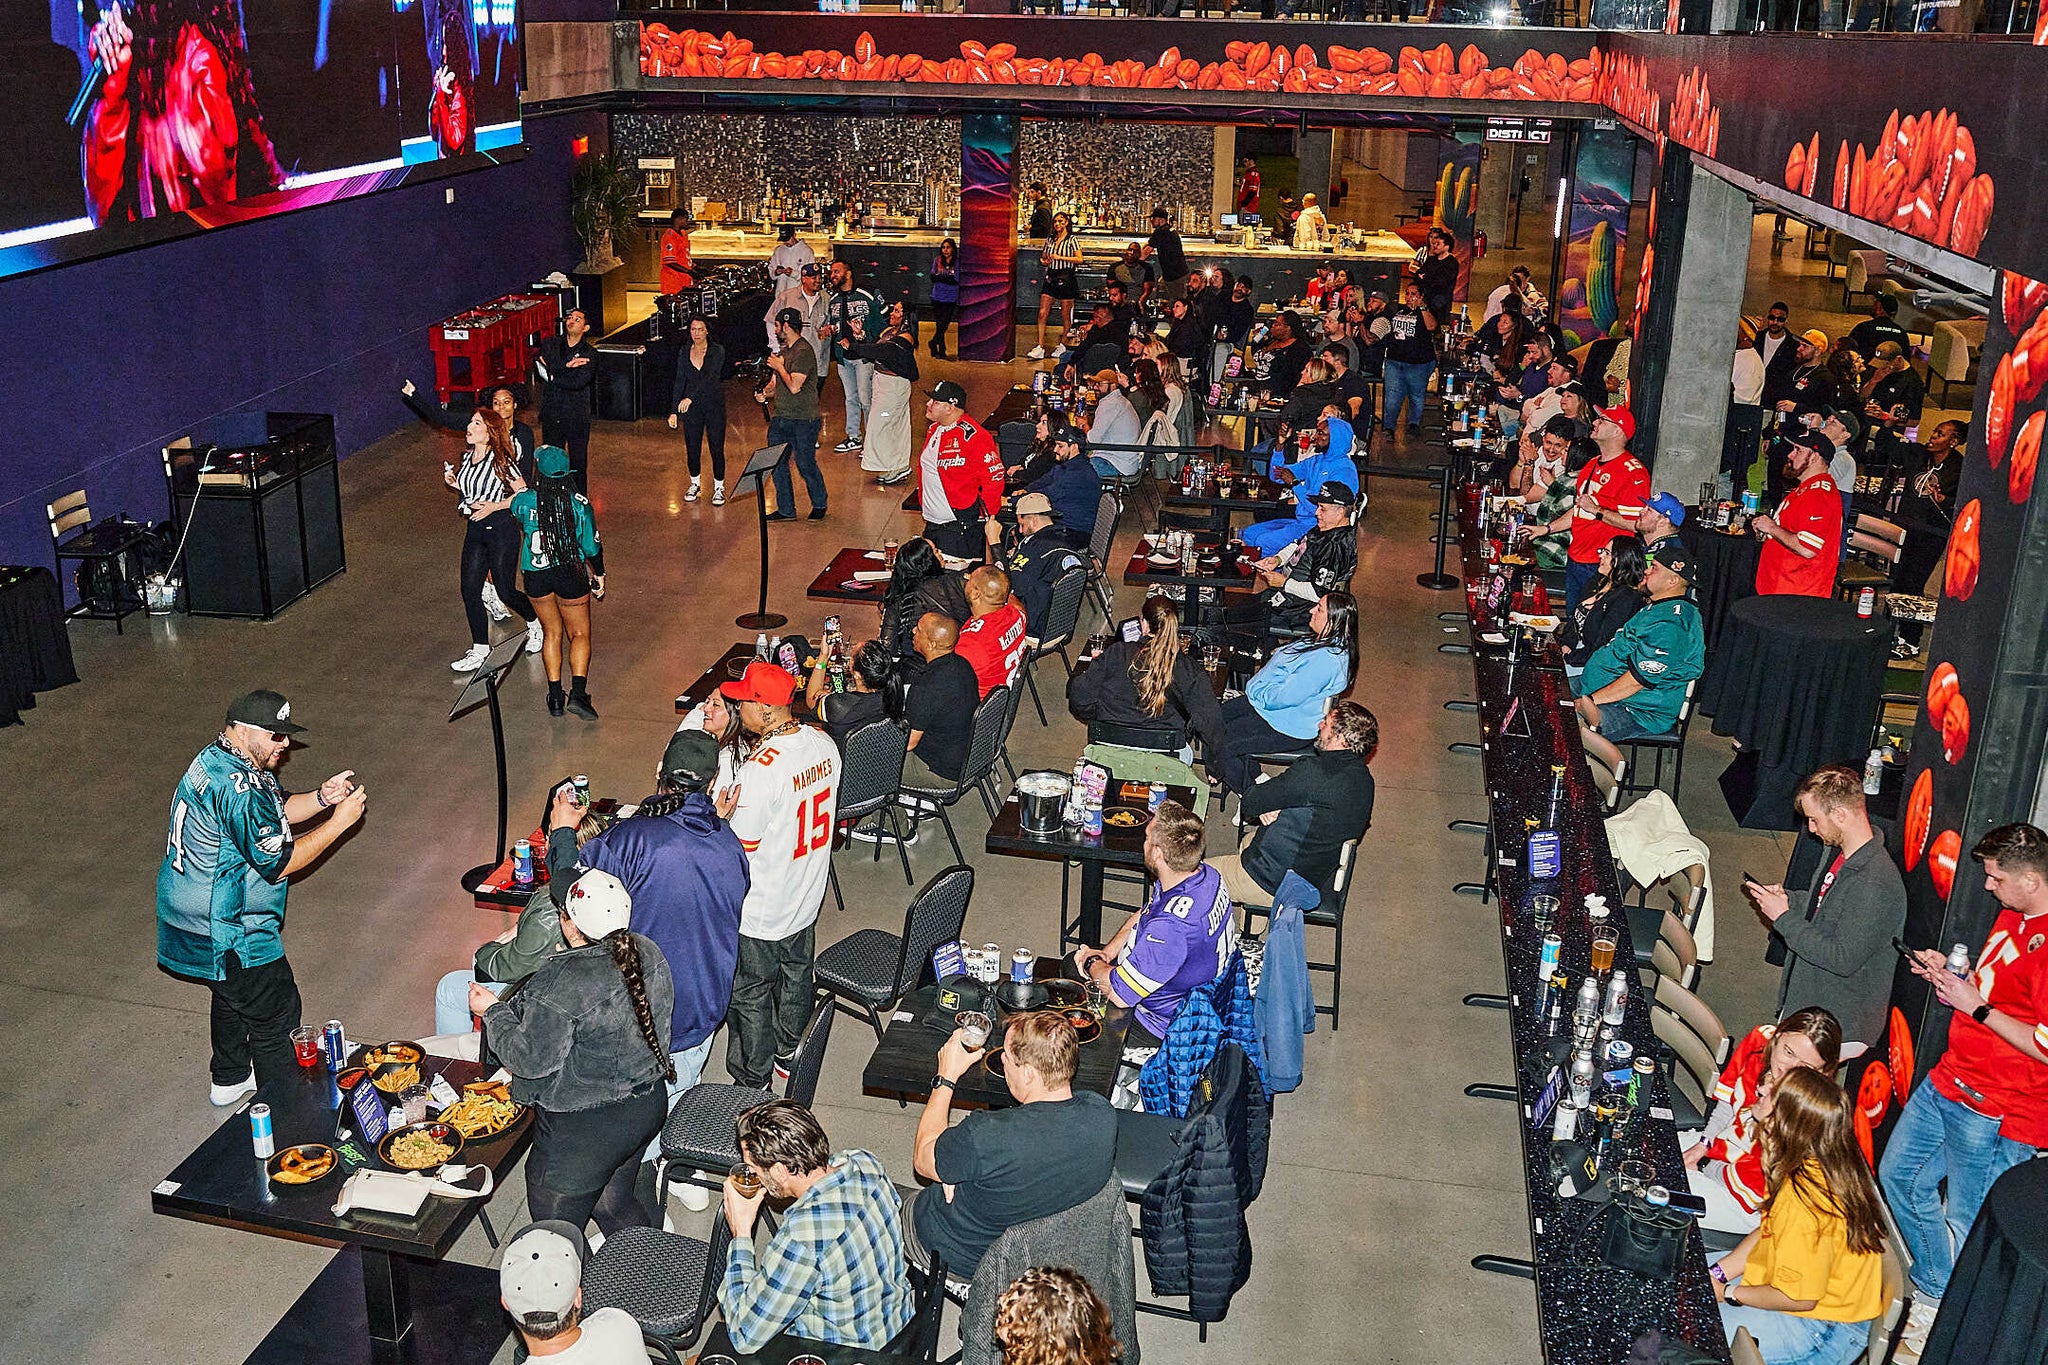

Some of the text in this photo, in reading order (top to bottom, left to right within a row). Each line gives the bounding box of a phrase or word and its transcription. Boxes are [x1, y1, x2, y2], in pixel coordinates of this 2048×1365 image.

[1623, 458, 1643, 472] 15
[229, 771, 264, 795] 24
[792, 757, 833, 793] MAHOMES
[792, 785, 831, 861] 15
[1163, 895, 1195, 919] 18
